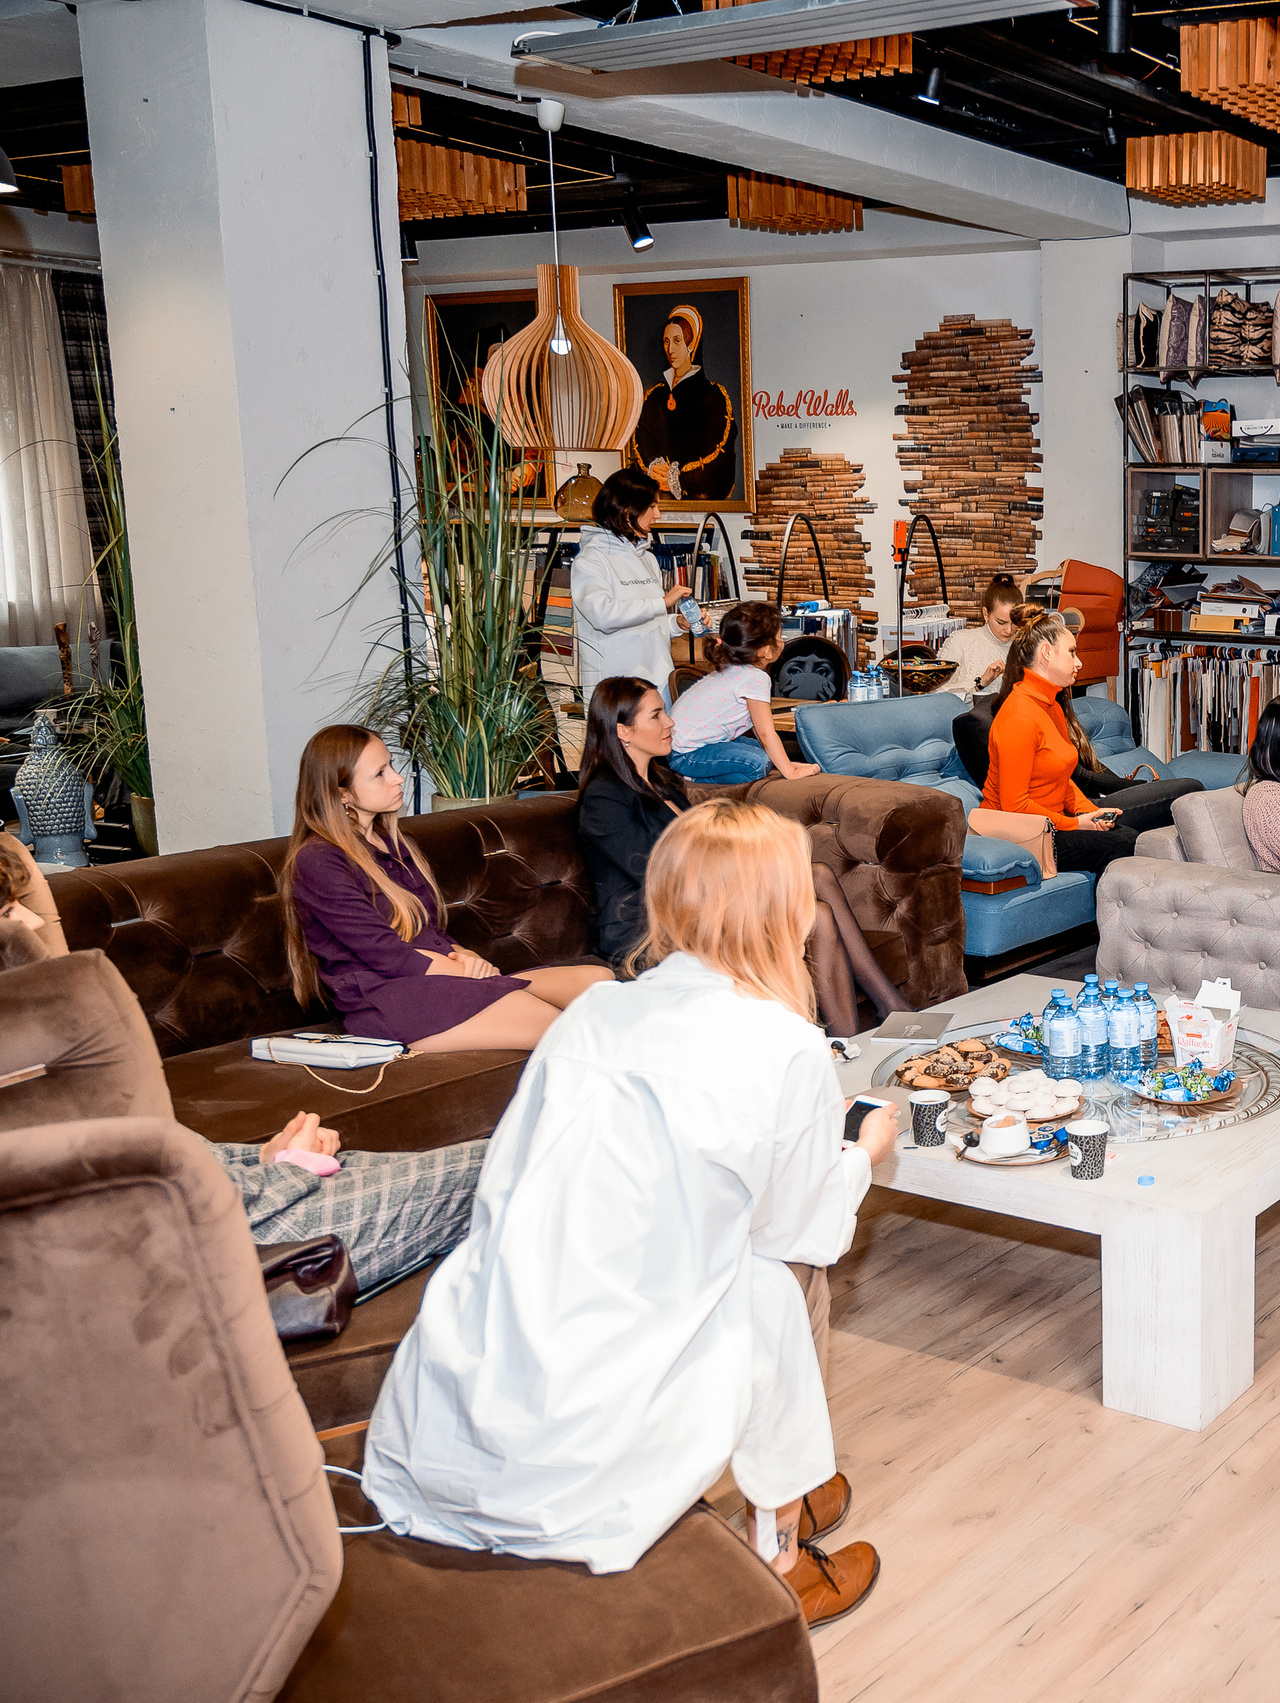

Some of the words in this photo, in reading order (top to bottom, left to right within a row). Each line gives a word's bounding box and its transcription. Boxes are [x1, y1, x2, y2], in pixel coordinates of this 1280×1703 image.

[752, 390, 802, 420] Rebel
[802, 389, 858, 417] Walls
[1177, 1037, 1213, 1049] Raffaello
